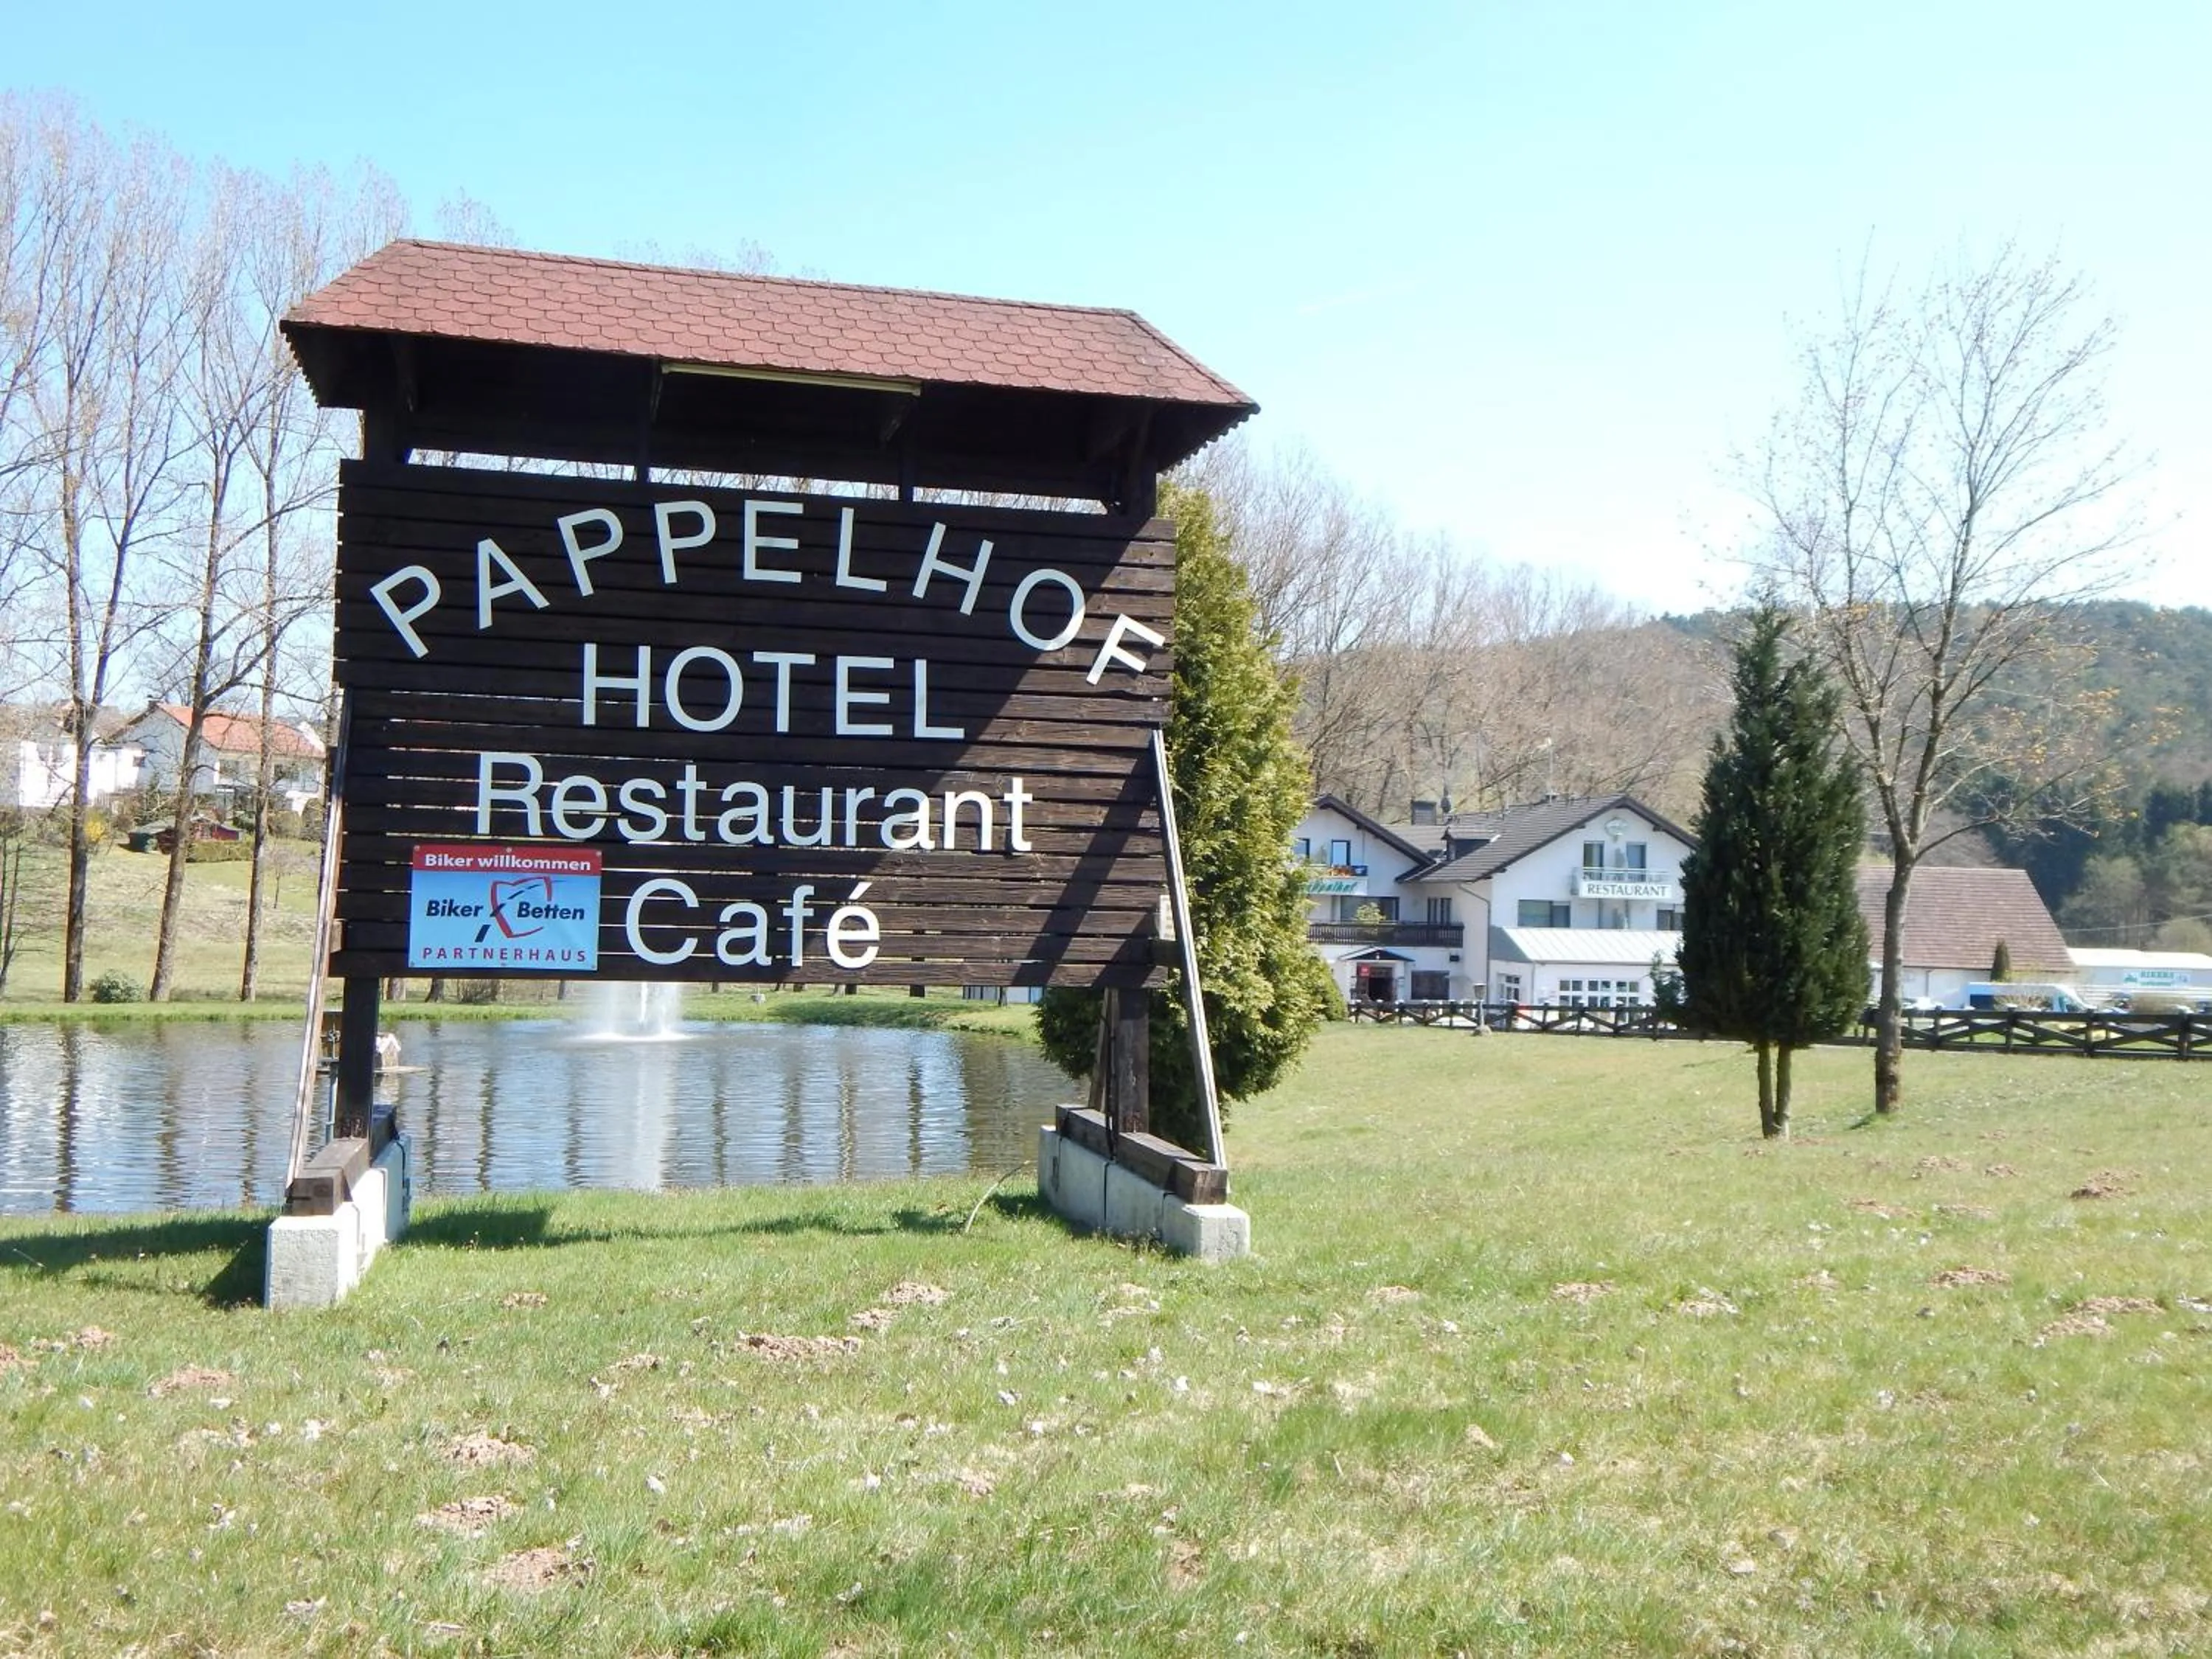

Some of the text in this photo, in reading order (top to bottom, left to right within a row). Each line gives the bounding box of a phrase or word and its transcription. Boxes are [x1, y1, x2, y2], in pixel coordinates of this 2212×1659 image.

[369, 500, 1166, 686] PAPPELHOF
[583, 642, 965, 738] HOTEL
[477, 752, 1033, 852] Restaurant
[425, 853, 591, 871] Biker willkommen
[1587, 883, 1670, 897] RESTAURANT
[425, 900, 585, 920] Biker Betten
[625, 877, 880, 969] Café
[422, 947, 586, 962] PARTNERHAUS
